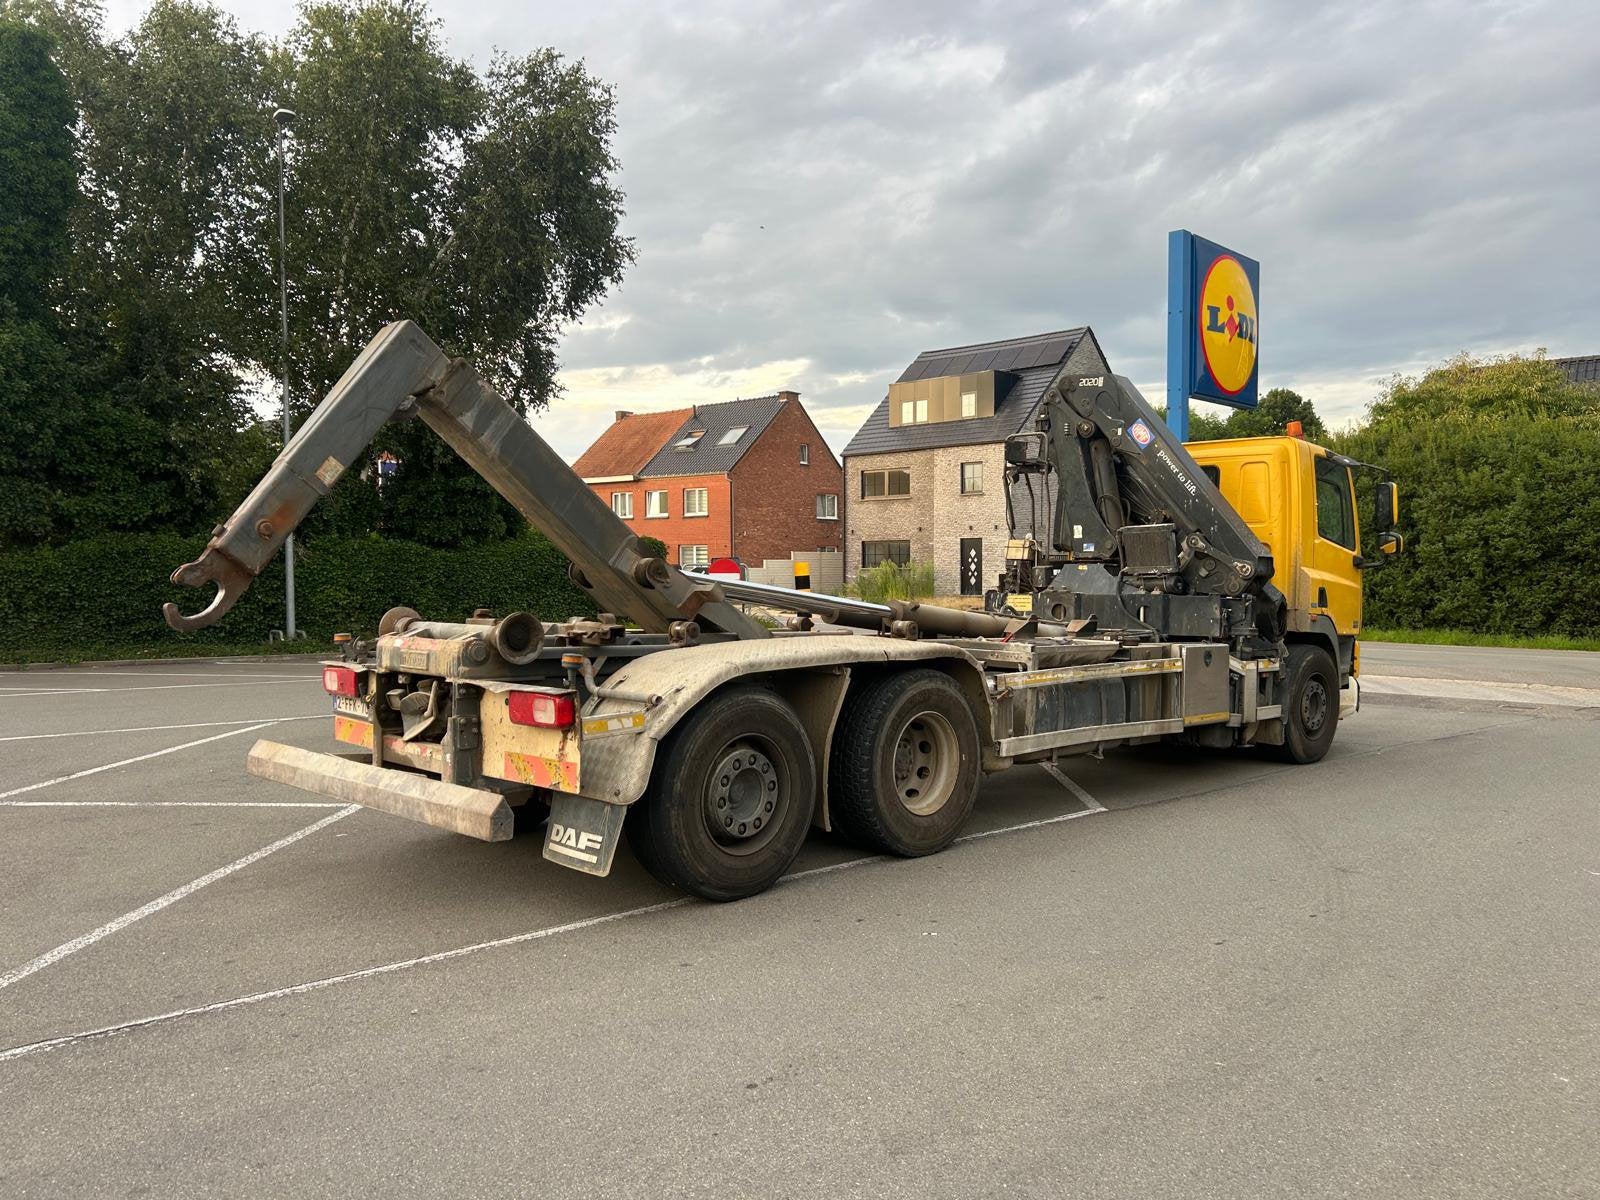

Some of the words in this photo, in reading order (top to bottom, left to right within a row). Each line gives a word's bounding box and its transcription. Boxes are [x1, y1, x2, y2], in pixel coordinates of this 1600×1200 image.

[1157, 450, 1179, 473] power
[1177, 473, 1186, 482] to
[1184, 480, 1197, 496] lift
[551, 824, 603, 850] DAF
